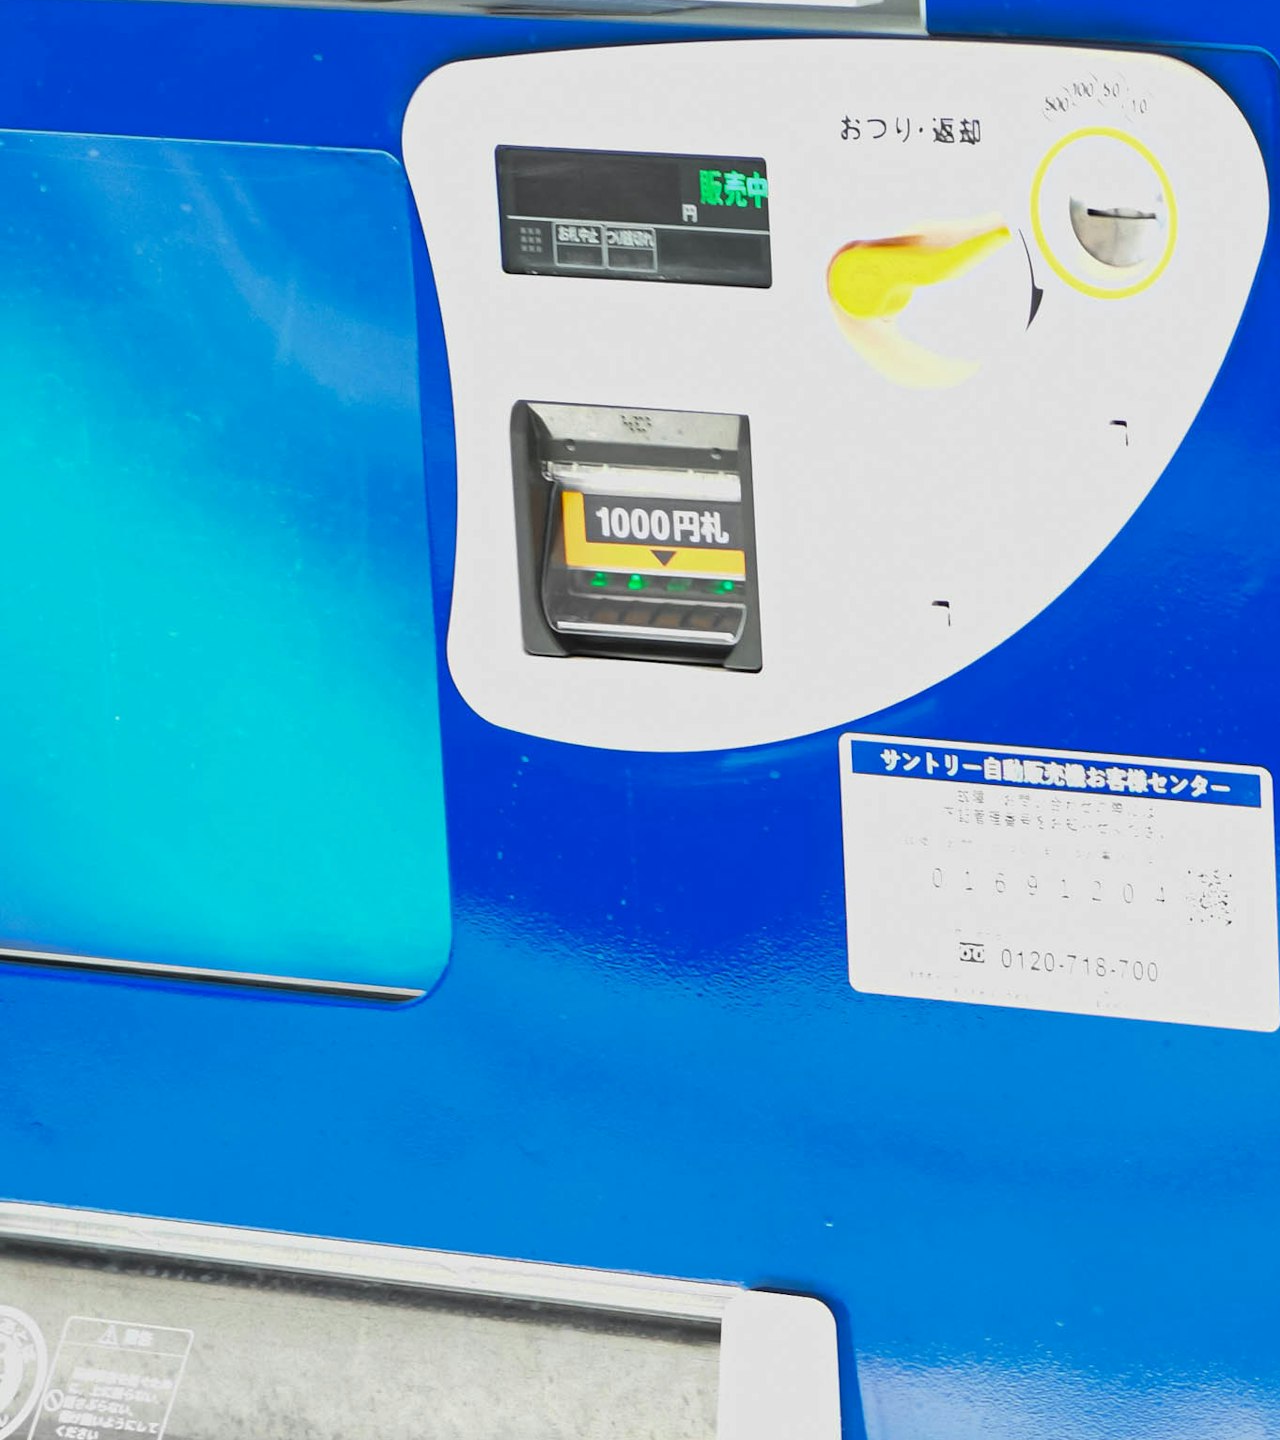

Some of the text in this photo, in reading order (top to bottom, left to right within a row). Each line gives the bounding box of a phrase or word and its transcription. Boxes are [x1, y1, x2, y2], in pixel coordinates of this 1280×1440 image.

[841, 115, 981, 144] おつり・返却
[699, 168, 769, 209] 販売中
[595, 506, 730, 544] 1000円札
[880, 747, 1232, 797] サントリー自動販売機お客様センター
[56, 1425, 99, 1440] ください
